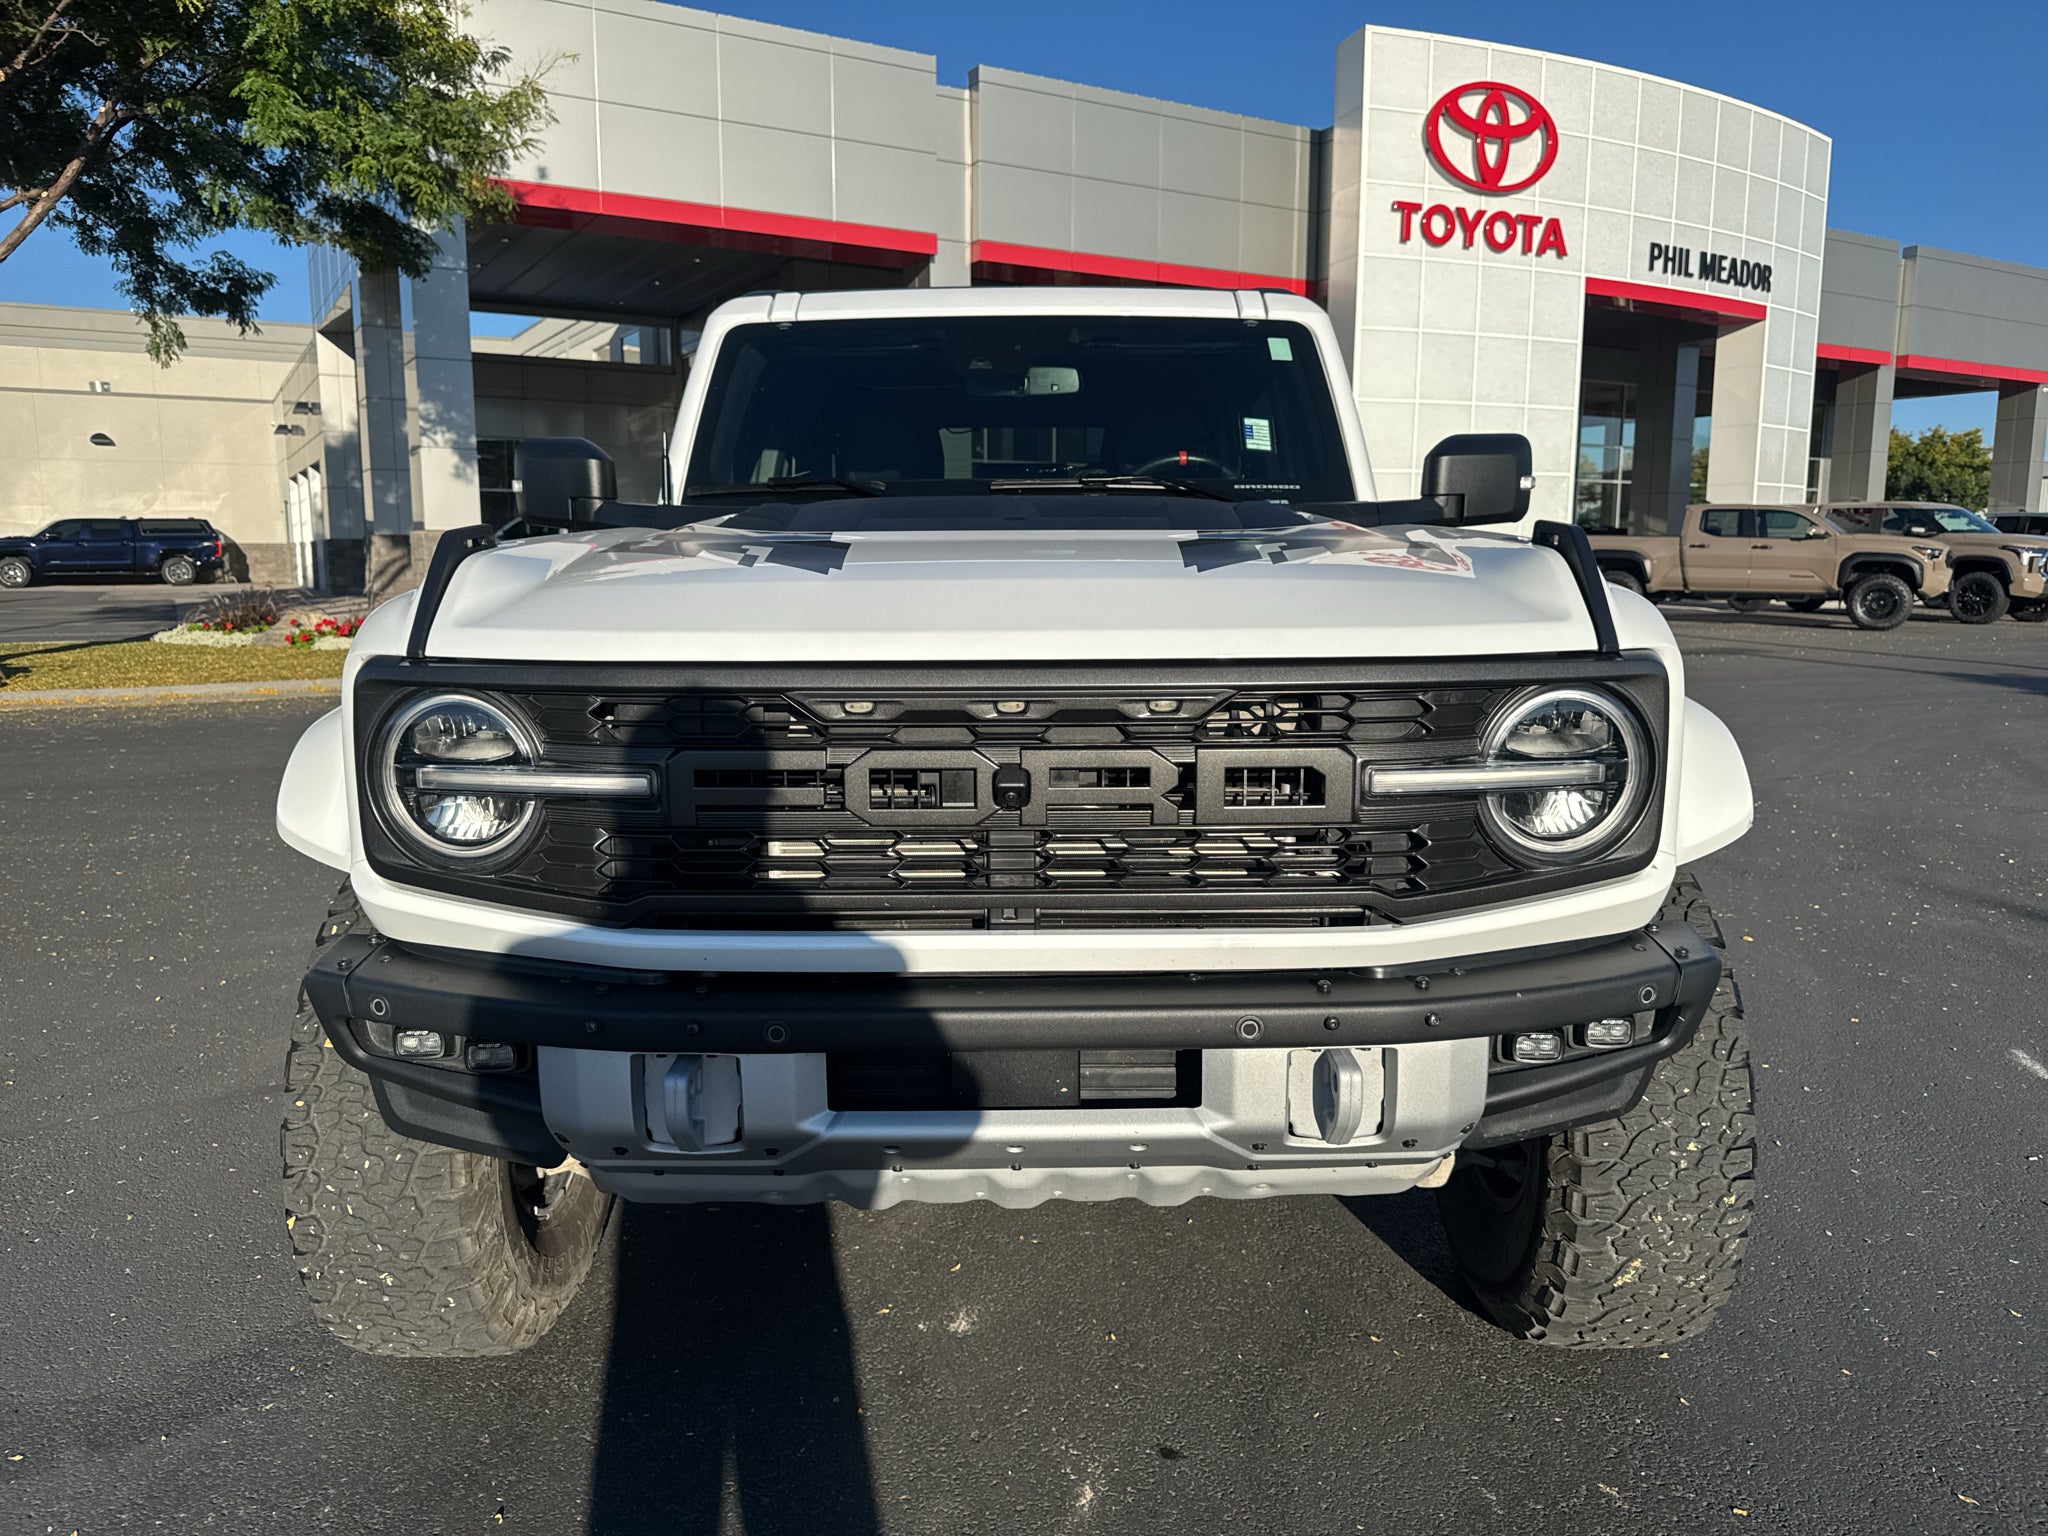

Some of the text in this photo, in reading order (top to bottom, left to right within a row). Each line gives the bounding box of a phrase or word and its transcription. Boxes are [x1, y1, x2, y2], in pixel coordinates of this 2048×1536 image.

[1392, 201, 1568, 257] TOYOTA
[1648, 242, 1772, 293] PHIL MEADOR
[668, 749, 1354, 827] FORD
